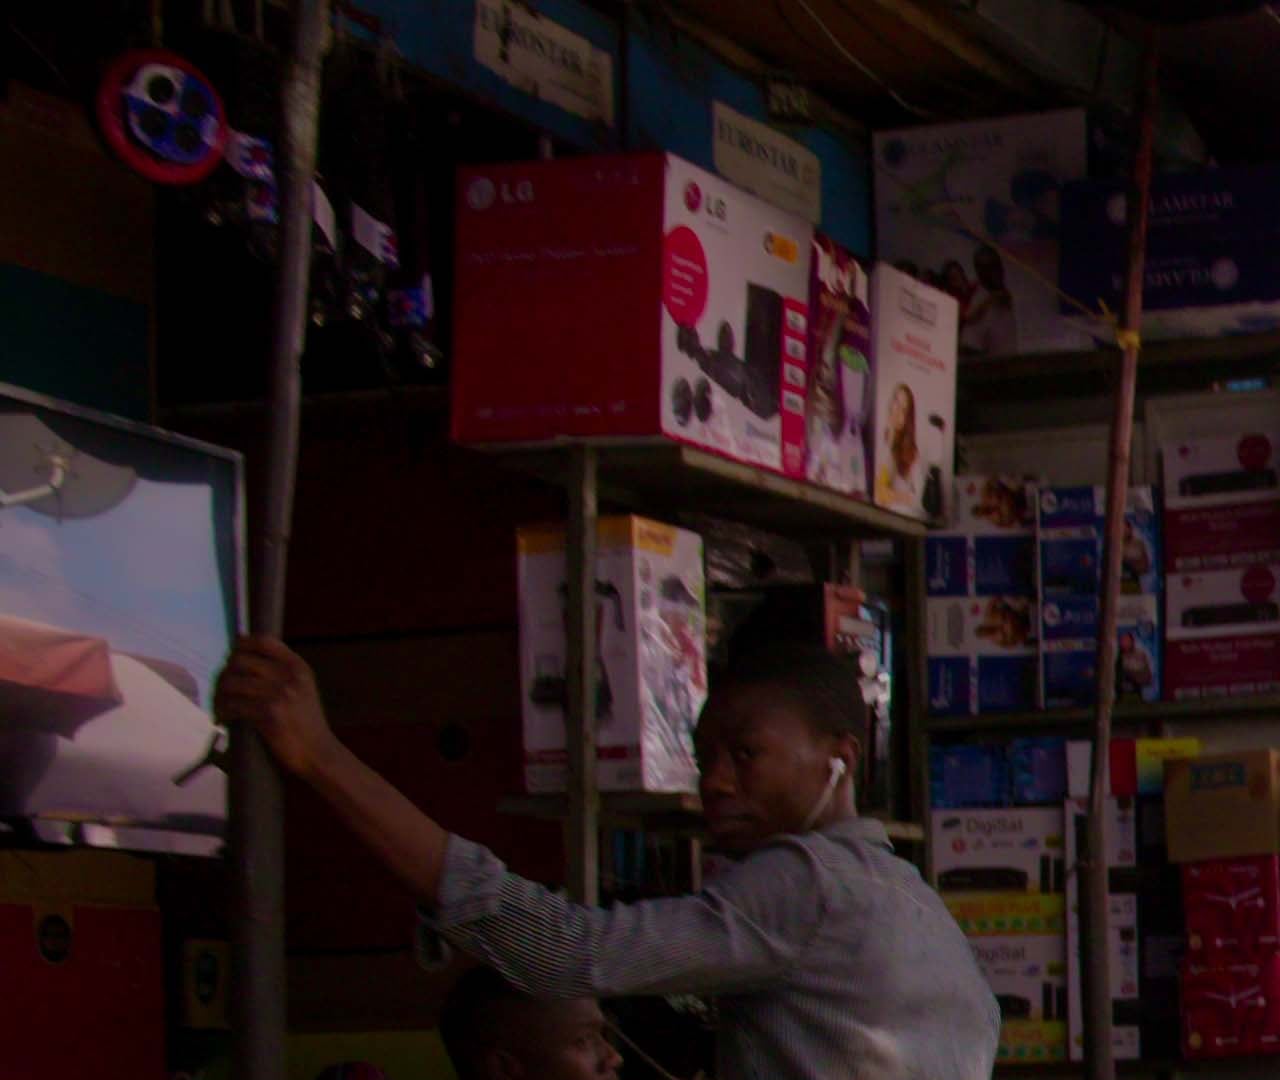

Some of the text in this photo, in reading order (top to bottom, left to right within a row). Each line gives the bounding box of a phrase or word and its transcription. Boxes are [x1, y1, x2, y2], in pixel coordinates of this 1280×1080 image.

[500, 180, 536, 207] LG
[704, 195, 728, 219] LG
[966, 816, 1024, 837] DigiSat
